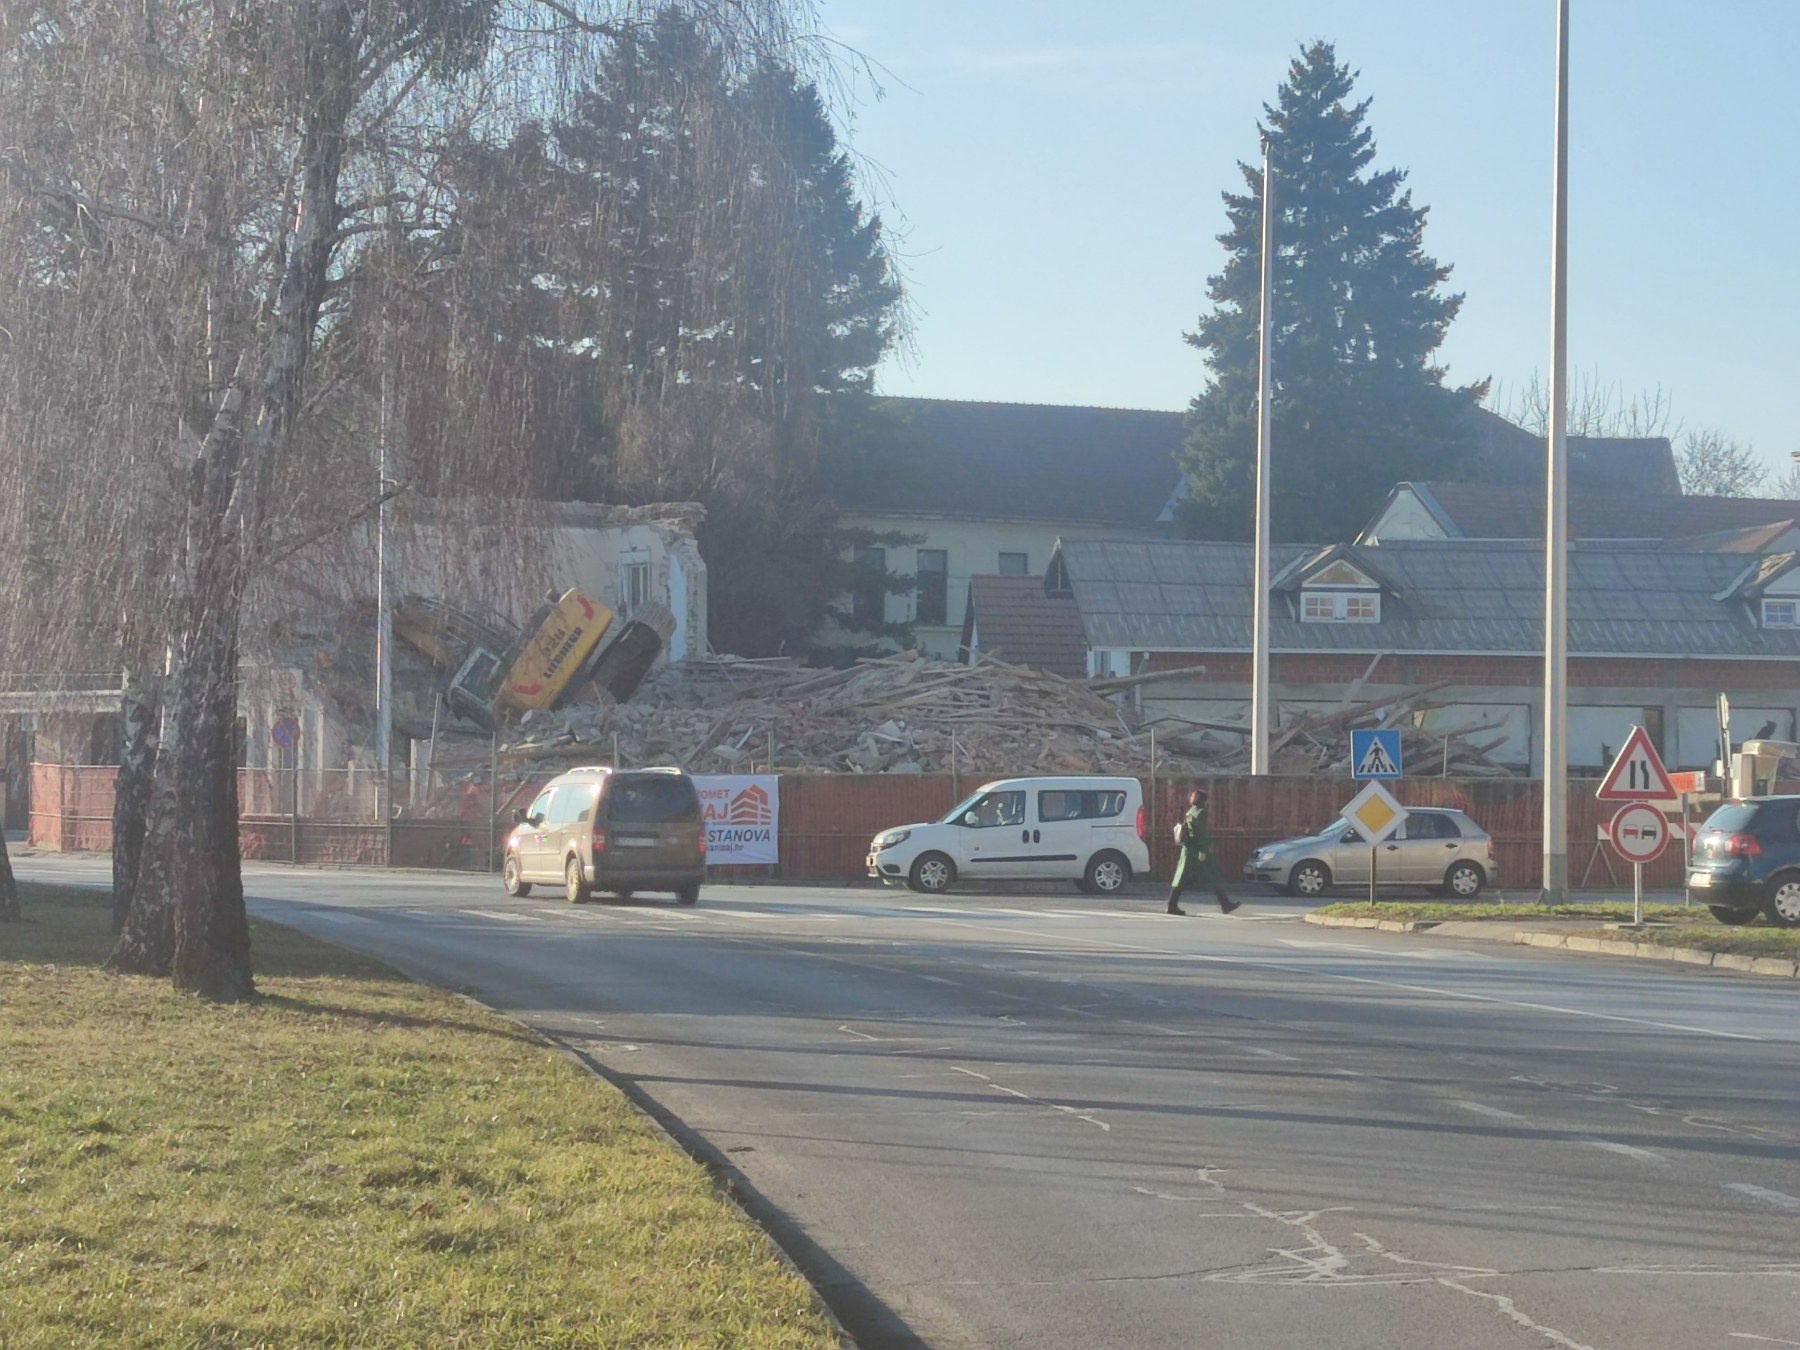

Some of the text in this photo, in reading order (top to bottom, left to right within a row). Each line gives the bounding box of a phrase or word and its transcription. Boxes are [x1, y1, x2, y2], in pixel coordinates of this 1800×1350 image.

[698, 789, 730, 800] OMET
[700, 803, 729, 820] AJ
[708, 829, 770, 842] STANOVA
